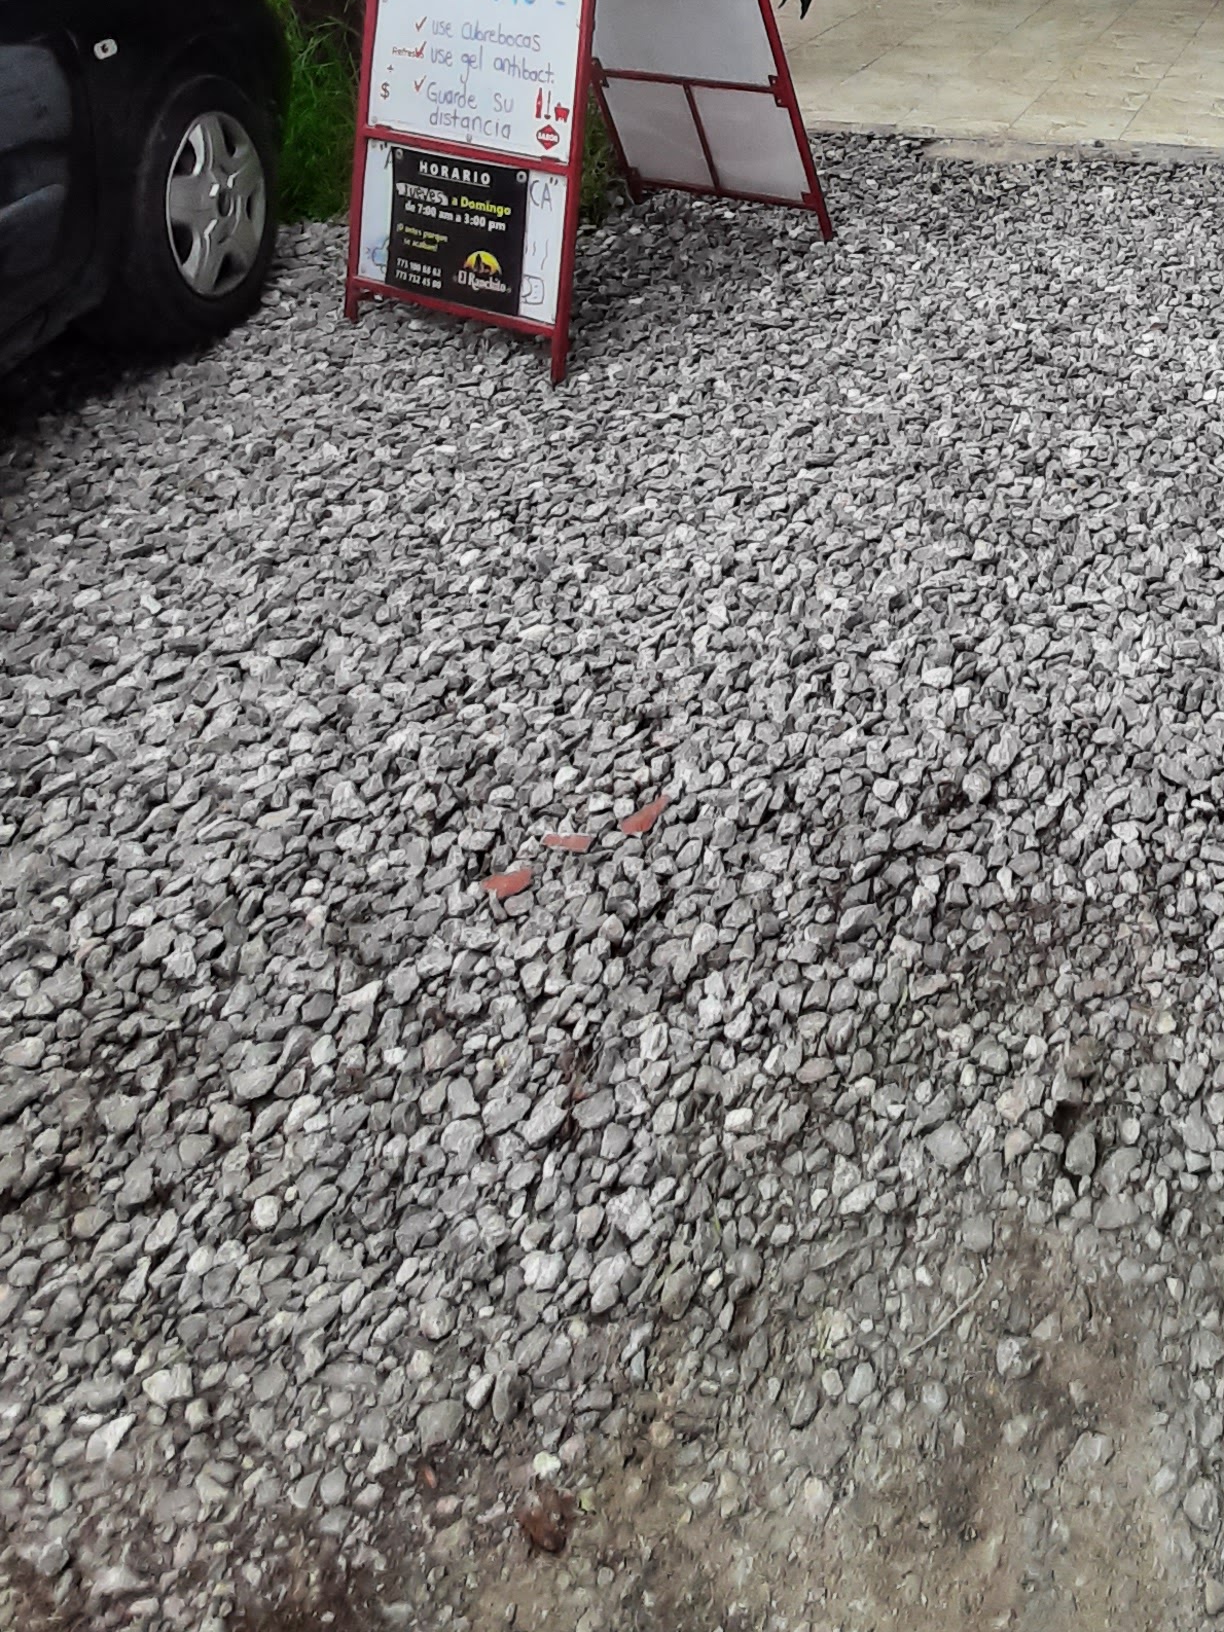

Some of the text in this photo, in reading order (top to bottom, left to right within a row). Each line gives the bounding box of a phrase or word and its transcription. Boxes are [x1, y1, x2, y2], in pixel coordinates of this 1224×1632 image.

[460, 45, 483, 84] gel
[380, 82, 390, 100] $
[426, 81, 477, 109] Guarde
[429, 106, 512, 139] distancia
[419, 160, 491, 186] HORARIO
[404, 200, 416, 213] de
[417, 203, 437, 217] 7:00
[455, 214, 462, 223] a
[464, 212, 486, 228] 3:00
[488, 219, 507, 232] pm
[451, 196, 458, 206] a
[460, 195, 512, 217] Domingo
